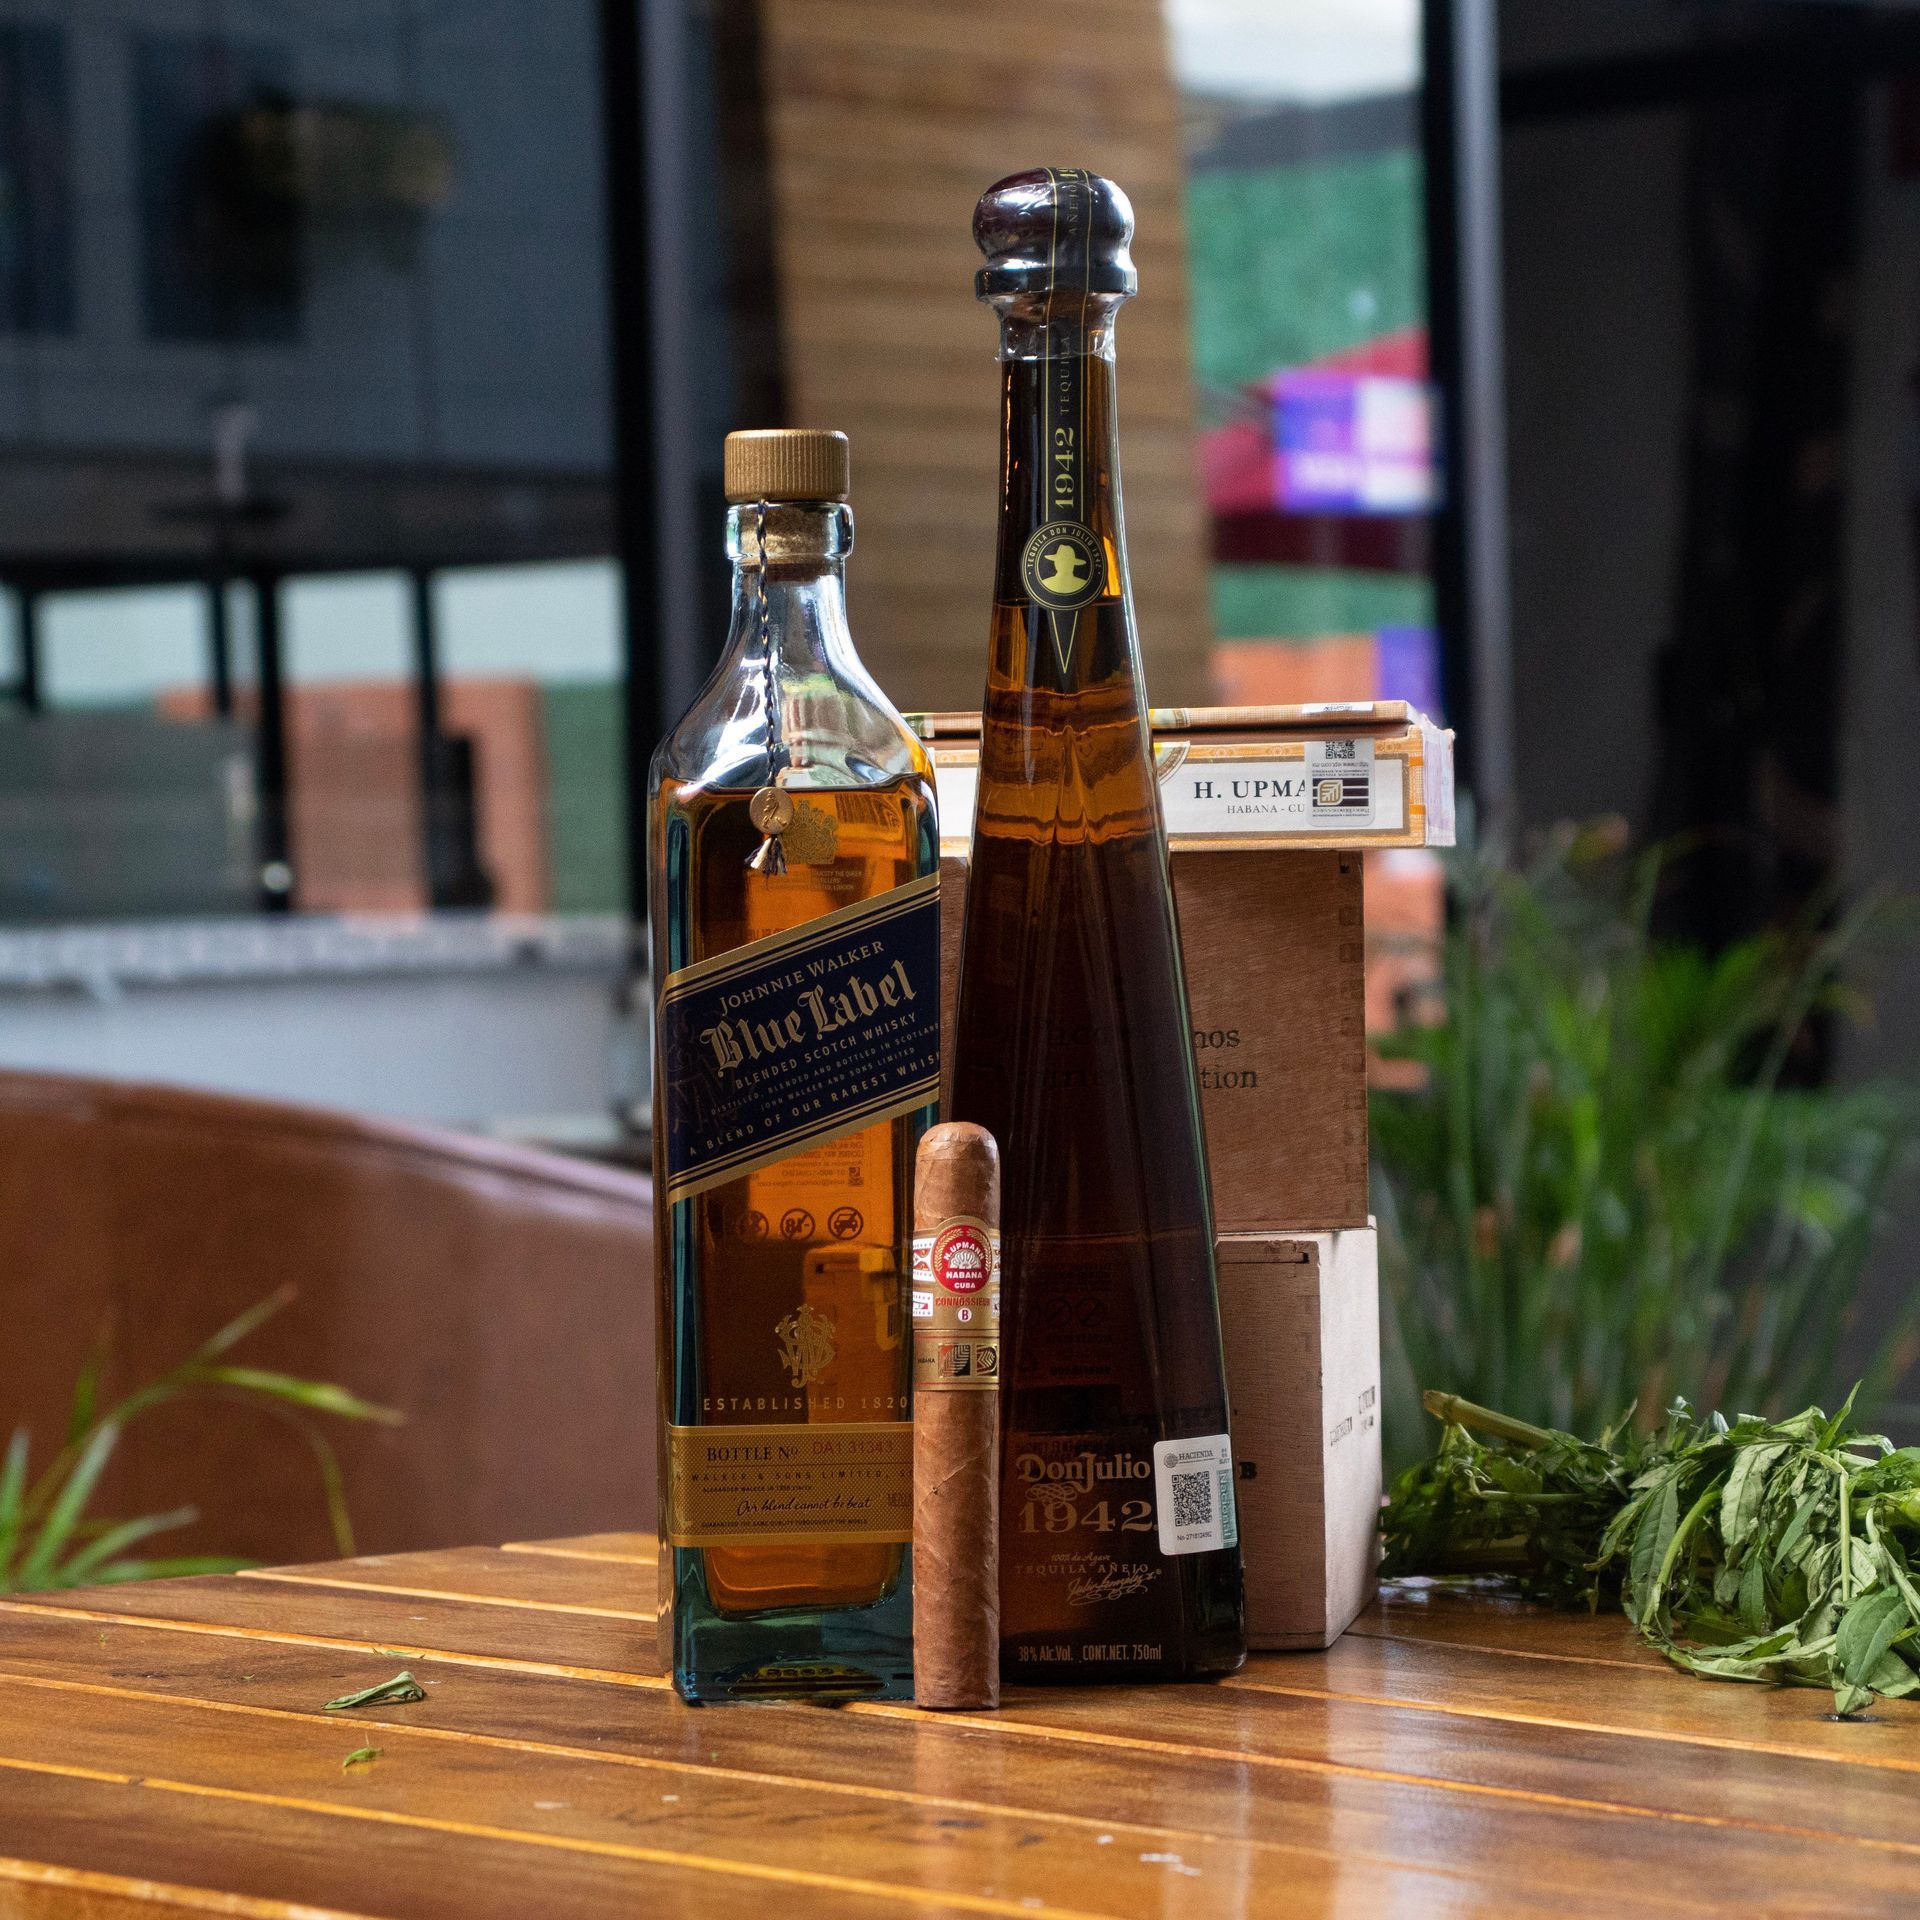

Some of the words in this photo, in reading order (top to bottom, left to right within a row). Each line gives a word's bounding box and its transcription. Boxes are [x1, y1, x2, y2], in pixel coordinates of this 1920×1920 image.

[1055, 427, 1075, 509] 1942
[1027, 534, 1049, 567] TEQUILA
[1050, 527, 1067, 536] DON
[1071, 528, 1093, 546] JULIO
[1194, 781, 1221, 799] H.
[1228, 804, 1278, 814] HABANA
[720, 970, 804, 1016] JOHNNIE
[807, 940, 885, 979] WALKER
[700, 1009, 806, 1078] Blue
[797, 959, 918, 1040] Label
[735, 1058, 798, 1090] BLENDED
[804, 1035, 856, 1063] SCOTCH
[862, 1012, 916, 1040] WHISKY
[761, 1098, 783, 1111] JOHN
[788, 1082, 822, 1100] WALKER
[828, 1074, 845, 1084] AND
[850, 1063, 873, 1076] SONS
[877, 1047, 916, 1066] LIMITED
[768, 1074, 809, 1094] BLENDED
[814, 1065, 832, 1076] AND
[836, 1048, 876, 1068] BOTTLED
[1200, 1065, 1258, 1089] tion
[690, 1147, 696, 1156] A
[706, 1124, 754, 1150] BLEND
[764, 1114, 780, 1128] OF
[792, 1100, 821, 1117] OUR
[830, 1073, 888, 1102] RAREST
[946, 1271, 982, 1280] HABANA
[961, 1310, 969, 1320] B
[703, 1396, 845, 1411] ESTABLISHED
[861, 1396, 908, 1410] 1820
[707, 1447, 772, 1462] BOTTLE
[1178, 1449, 1214, 1460] HACIENDA
[760, 1497, 796, 1512] blend
[794, 1500, 829, 1510] cannot
[1219, 1472, 1233, 1538] Nacional
[1016, 1564, 1086, 1576] TEQUILA
[1097, 1562, 1148, 1574] AÑEJO
[1018, 1646, 1038, 1662] 38%
[1082, 1644, 1130, 1660] CONT.NET.
[1132, 1644, 1162, 1660] 750ml
